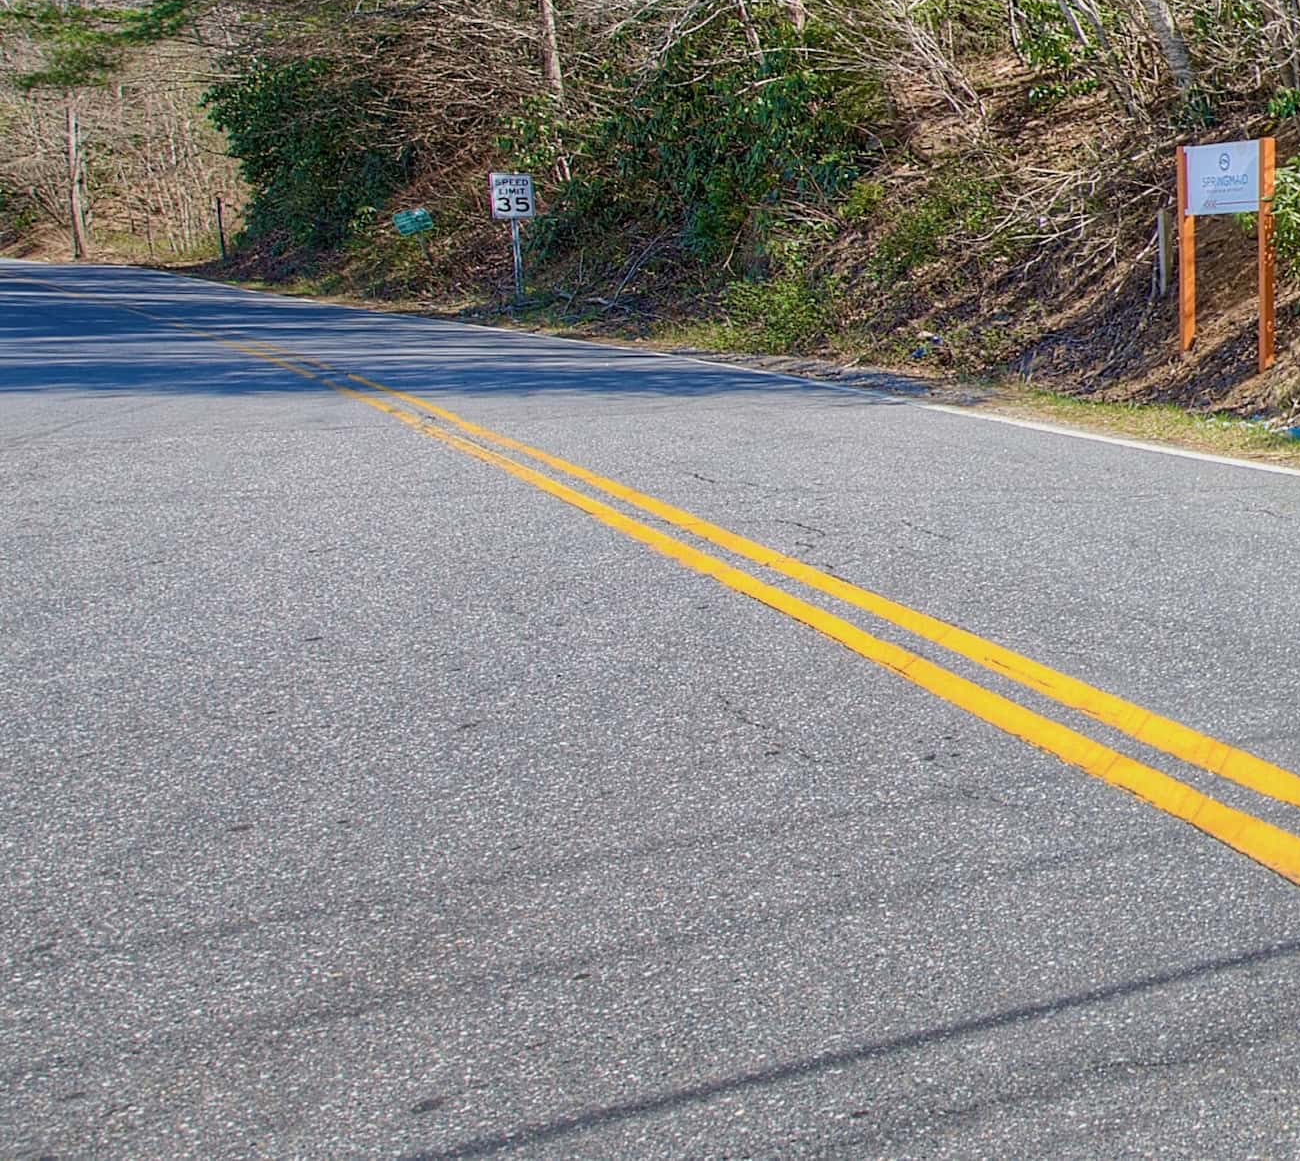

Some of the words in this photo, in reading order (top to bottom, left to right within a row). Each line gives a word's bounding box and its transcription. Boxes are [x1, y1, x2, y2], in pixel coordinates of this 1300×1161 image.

[495, 178, 529, 186] SPEED
[1201, 173, 1249, 188] SPRINGMAID
[496, 197, 530, 212] 35
